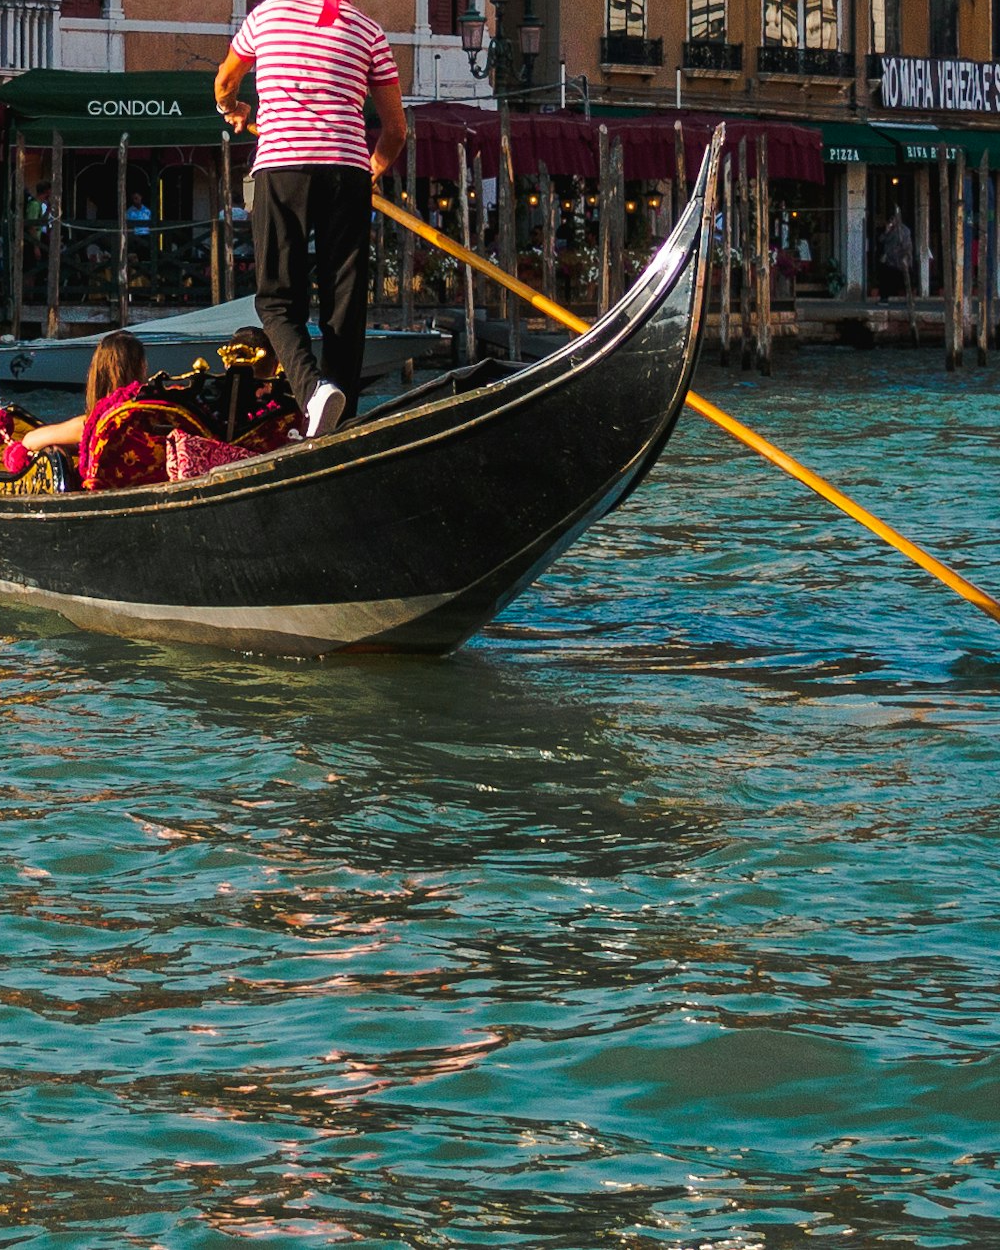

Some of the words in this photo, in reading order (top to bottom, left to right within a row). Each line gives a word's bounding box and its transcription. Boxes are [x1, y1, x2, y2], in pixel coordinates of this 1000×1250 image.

[881, 57, 899, 109] NO
[900, 58, 934, 109] MAFIA
[937, 60, 983, 111] VENEZIA
[87, 100, 182, 116] GONDOLA
[829, 148, 860, 161] PIZZA
[907, 146, 928, 159] RIVA
